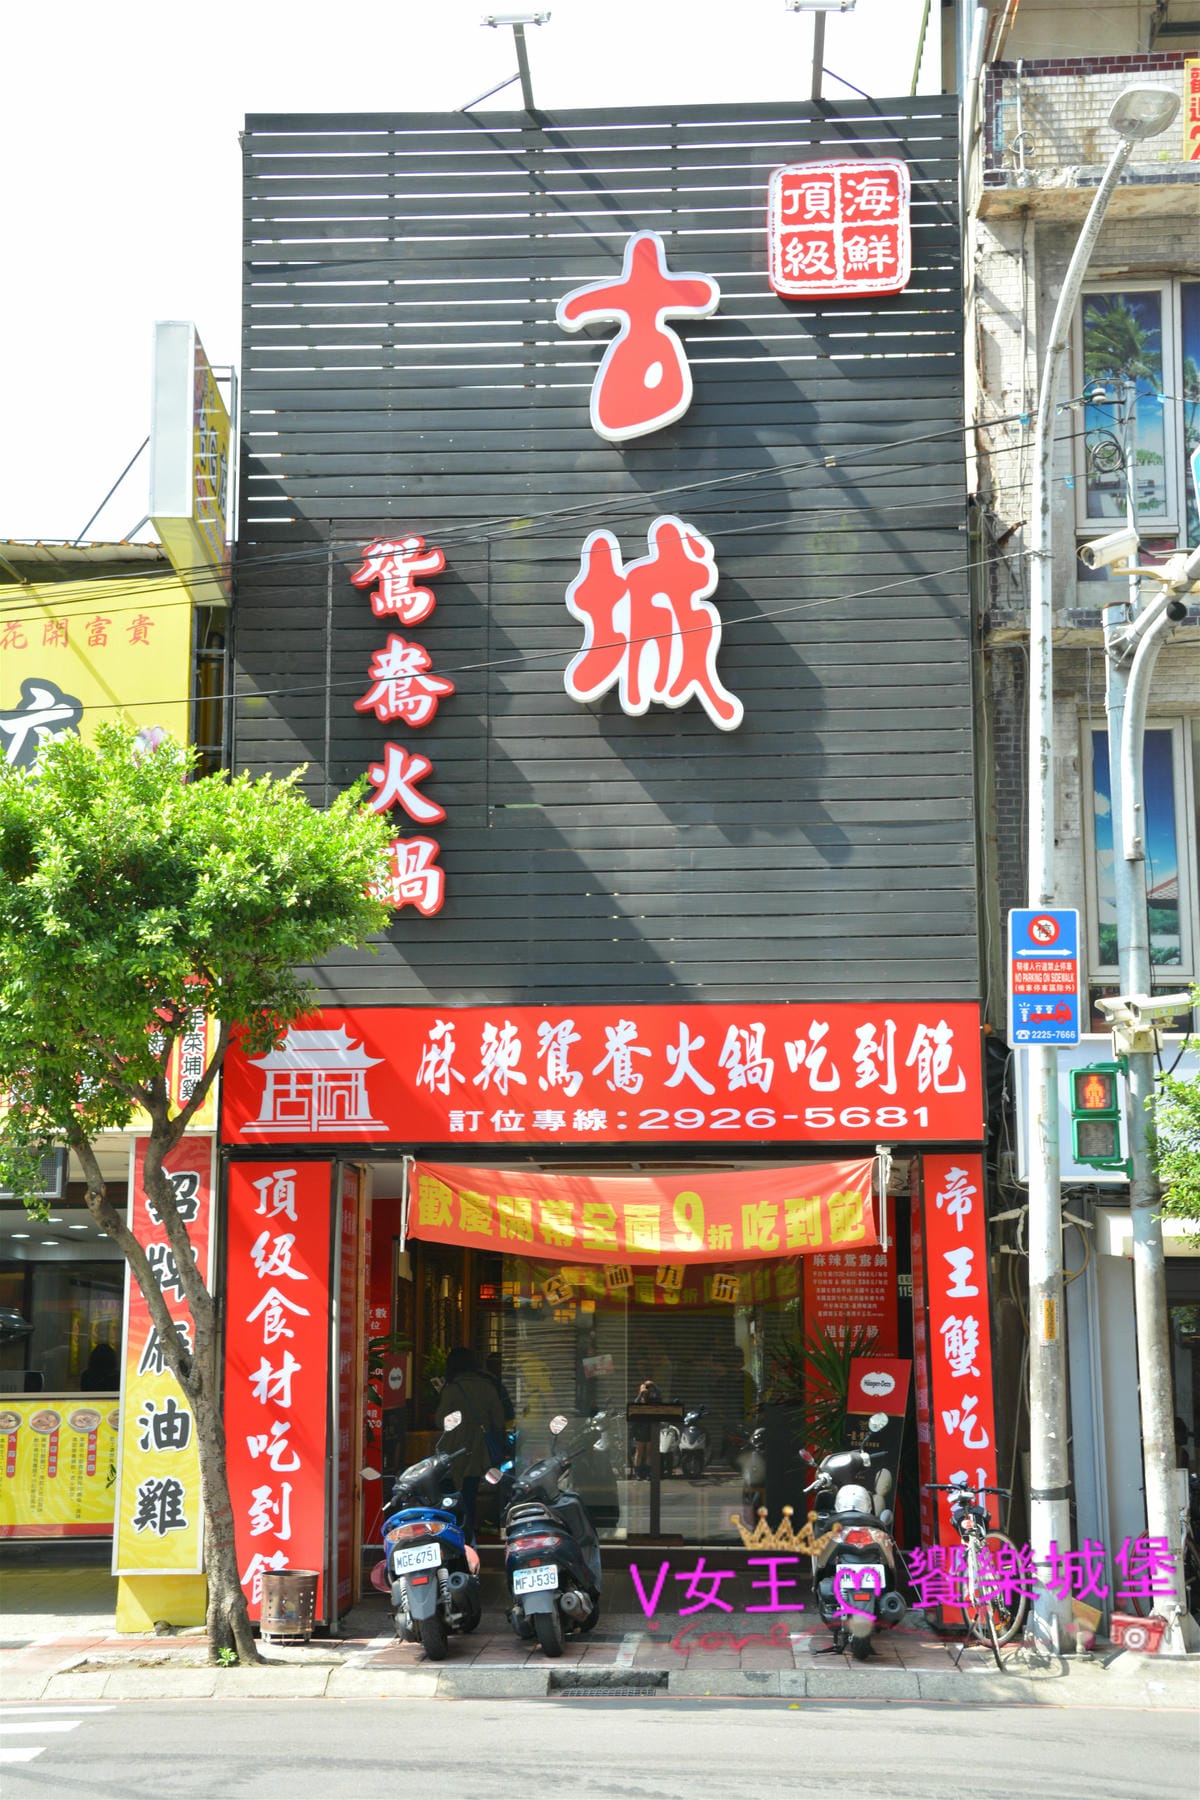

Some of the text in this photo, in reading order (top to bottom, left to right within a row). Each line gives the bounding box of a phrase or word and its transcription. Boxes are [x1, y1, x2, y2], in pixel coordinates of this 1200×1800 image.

[784, 179, 835, 277] 頂級
[843, 177, 897, 274] 海鮮
[555, 228, 745, 732] 古城
[0, 614, 156, 651] 花開富貴
[1014, 972, 1074, 983] NO PARKING ON SIDEWALK
[415, 1018, 967, 1098] 麻辣鴛鴦火鍋吃到飽
[1031, 1030, 1076, 1039] 2225-7666
